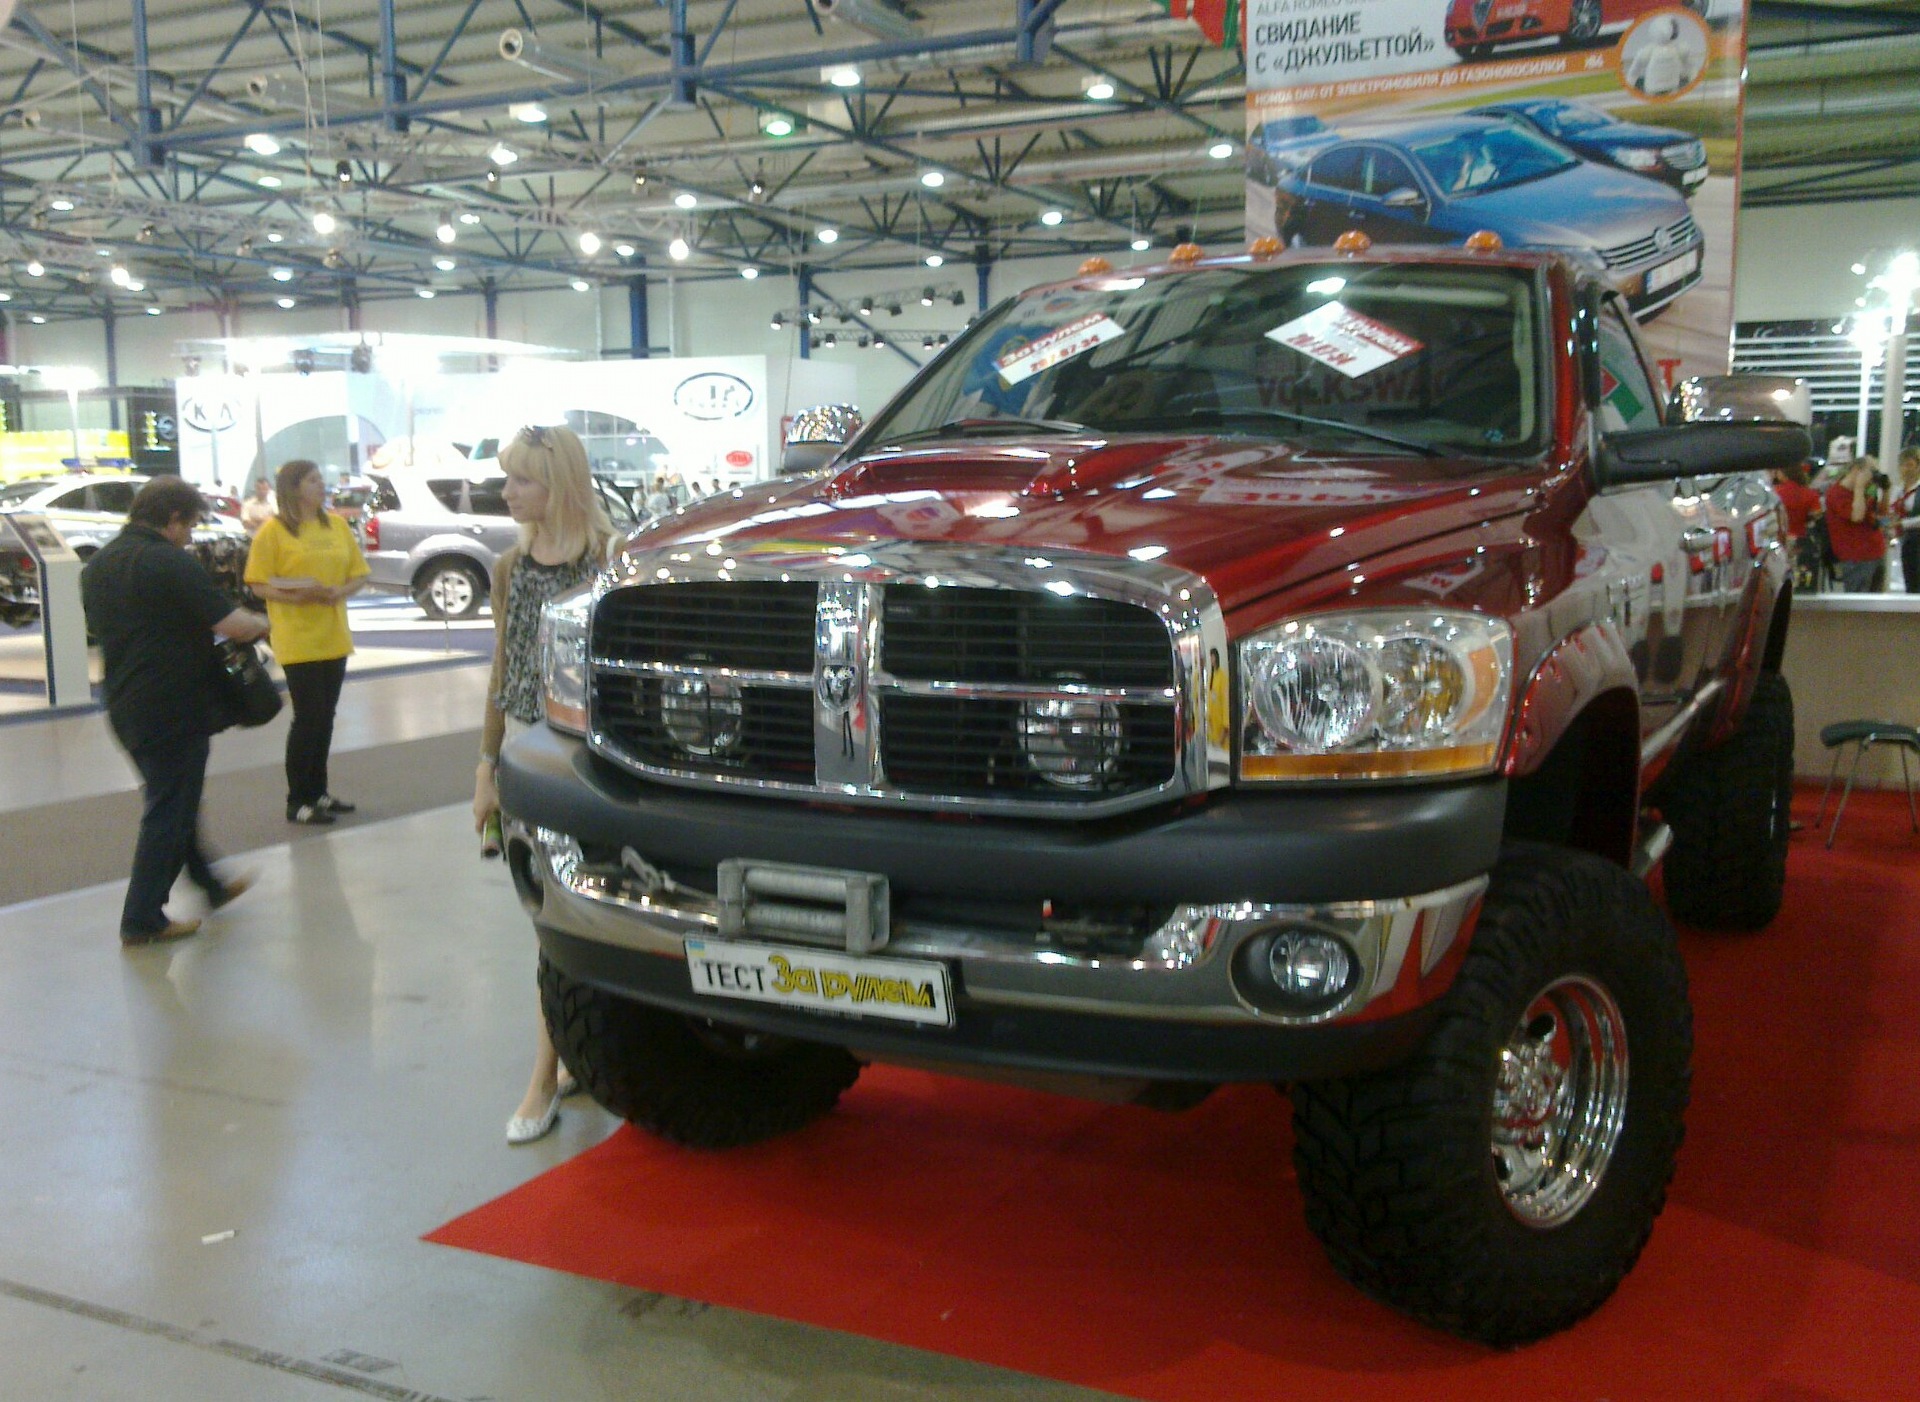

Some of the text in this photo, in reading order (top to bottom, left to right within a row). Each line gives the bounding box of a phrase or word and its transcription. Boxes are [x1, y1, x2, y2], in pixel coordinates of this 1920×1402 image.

[1256, 3, 1290, 17] ALFA
[1255, 11, 1361, 46] СВИДАНИЕ
[1255, 26, 1435, 74] С «ДЖУЛЬЕТТОЙ»
[1440, 70, 1459, 88] ДО
[702, 960, 765, 992] ТЕСТ
